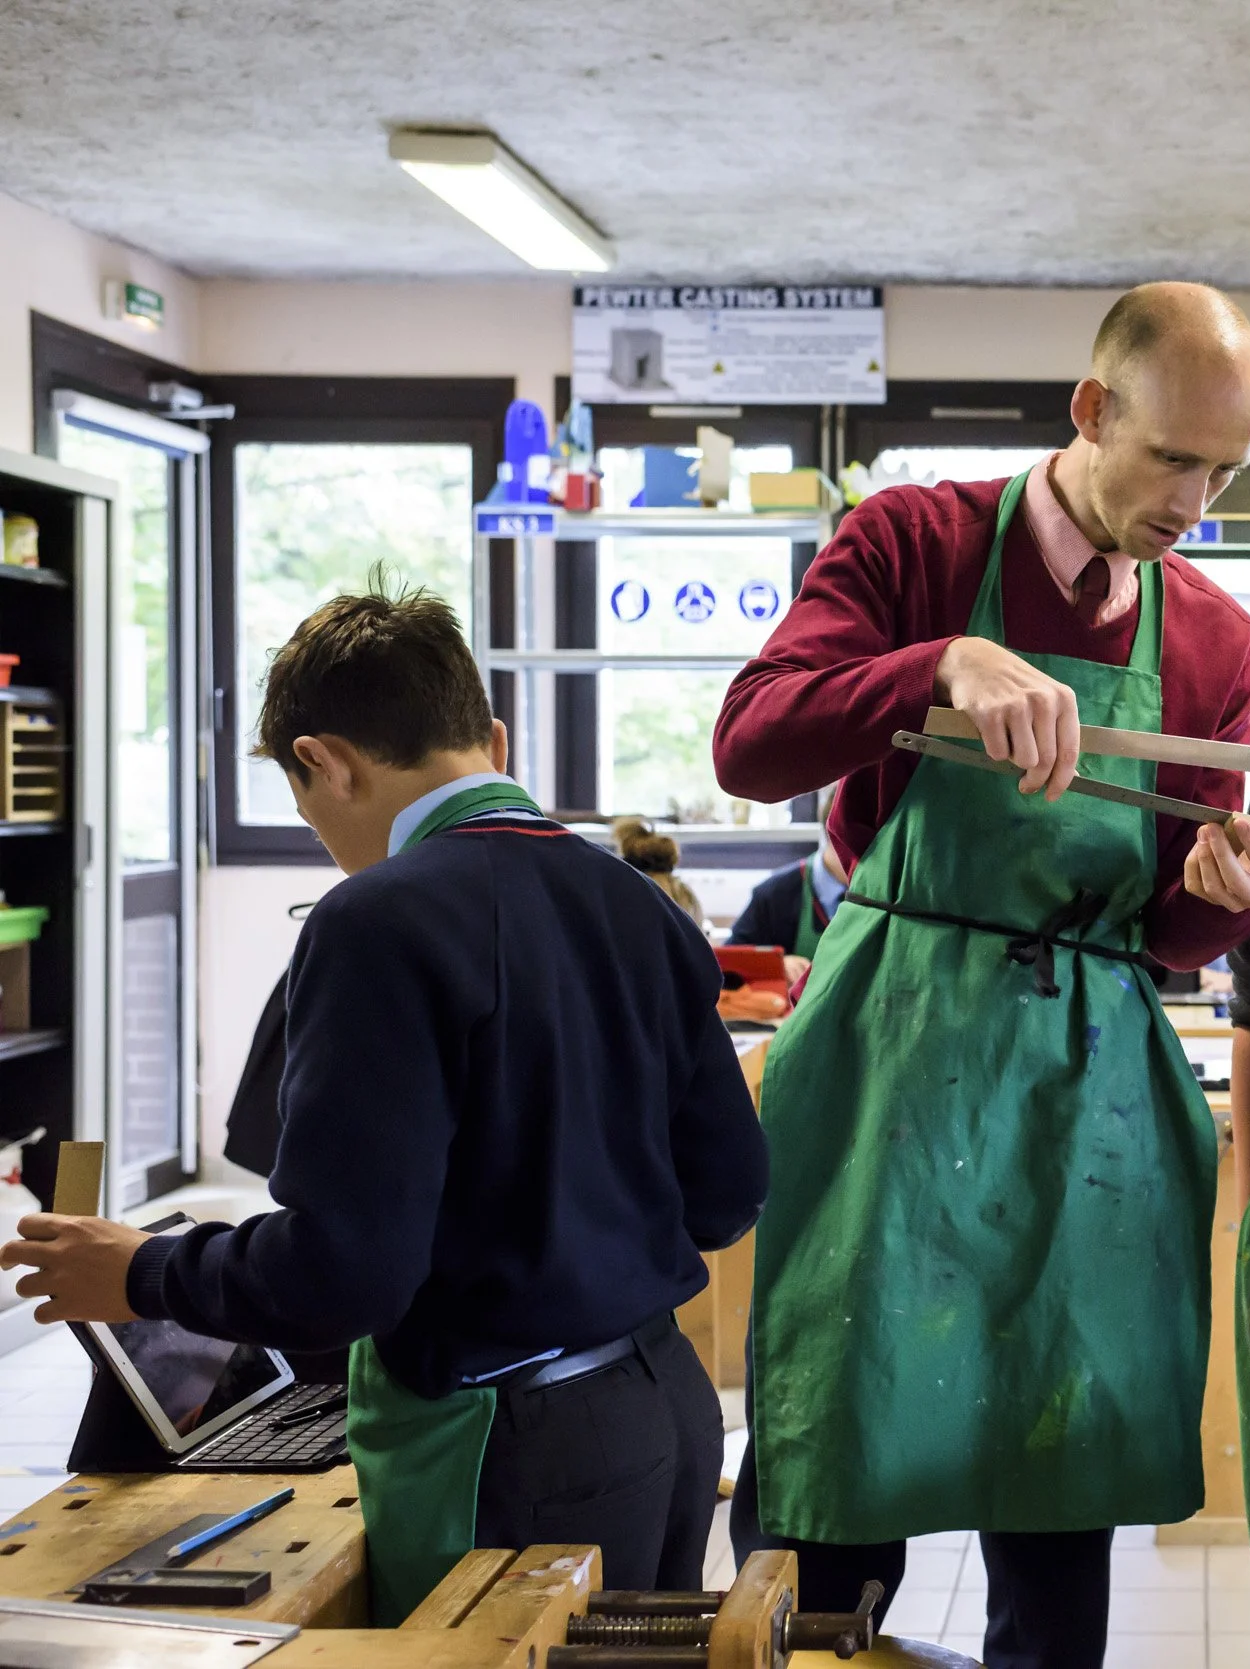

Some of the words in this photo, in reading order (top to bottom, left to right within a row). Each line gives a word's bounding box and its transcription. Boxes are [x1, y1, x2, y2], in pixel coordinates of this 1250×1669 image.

[583, 288, 675, 309] PEWTER
[680, 287, 778, 309] CASTING
[783, 287, 874, 309] SYSTEM
